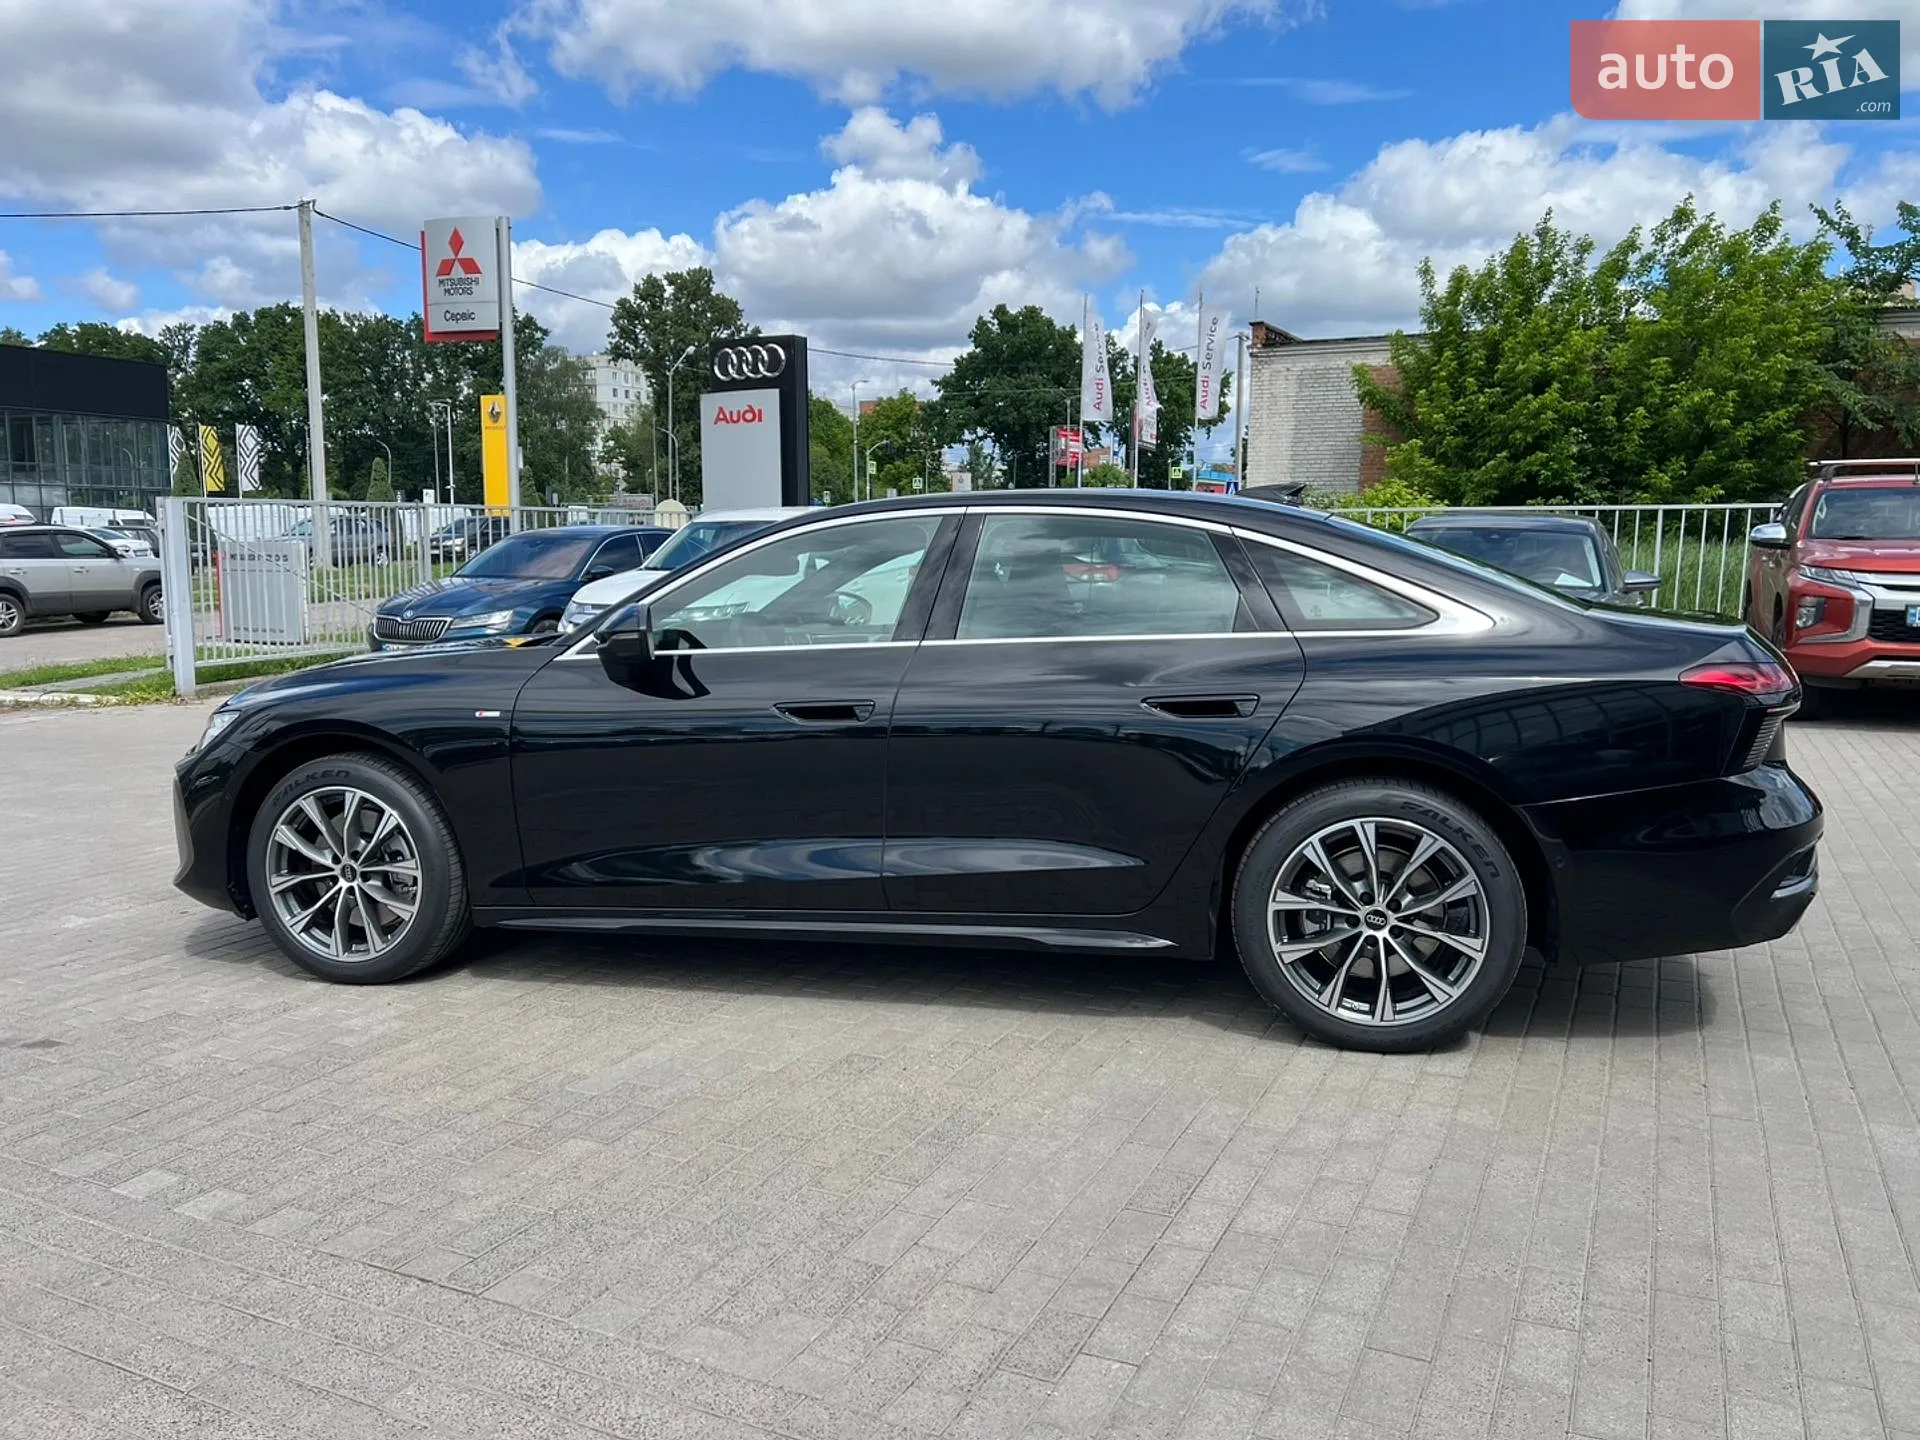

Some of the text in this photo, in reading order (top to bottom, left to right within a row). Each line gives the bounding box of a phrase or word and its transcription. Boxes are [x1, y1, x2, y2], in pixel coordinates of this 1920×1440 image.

[438, 277, 480, 288] MITSUBISHI
[443, 286, 474, 297] MOTORS
[443, 309, 476, 323] Сервіс
[1200, 316, 1219, 410] Audi Service
[1093, 377, 1104, 412] Audi
[713, 404, 764, 426] Audi
